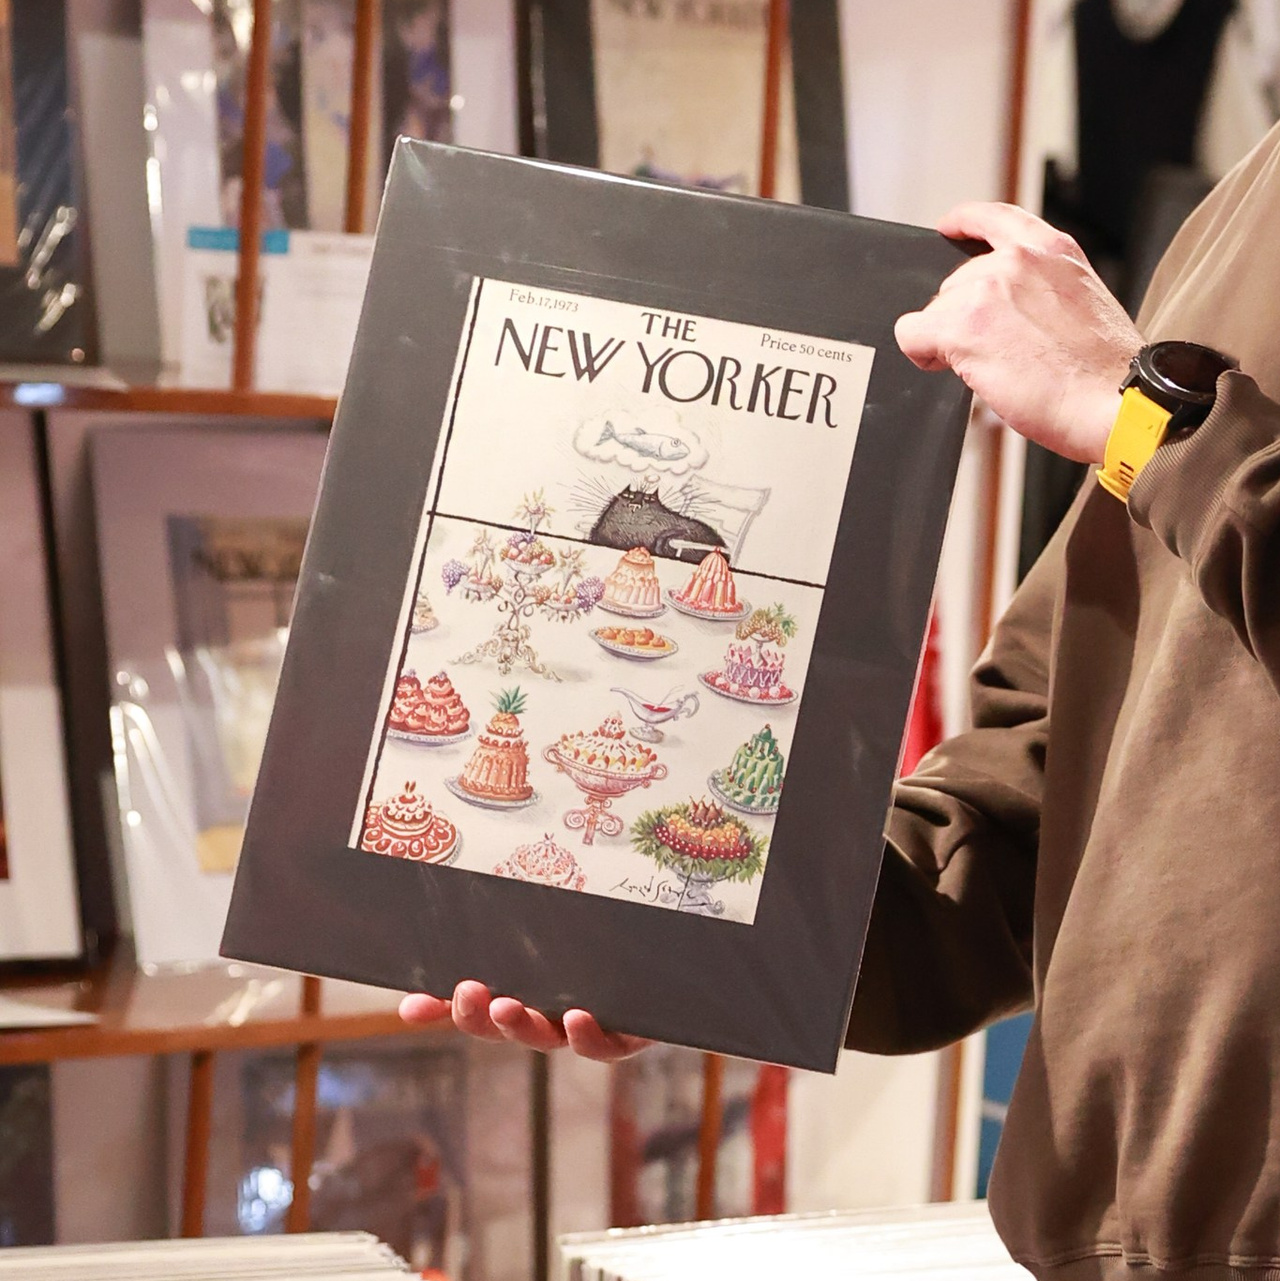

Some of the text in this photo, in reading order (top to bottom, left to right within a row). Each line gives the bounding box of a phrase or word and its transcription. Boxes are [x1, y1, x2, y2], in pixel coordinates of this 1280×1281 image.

[641, 312, 697, 342] THE
[760, 333, 853, 363] Price 50 cents
[494, 317, 838, 429] NEW YORKER
